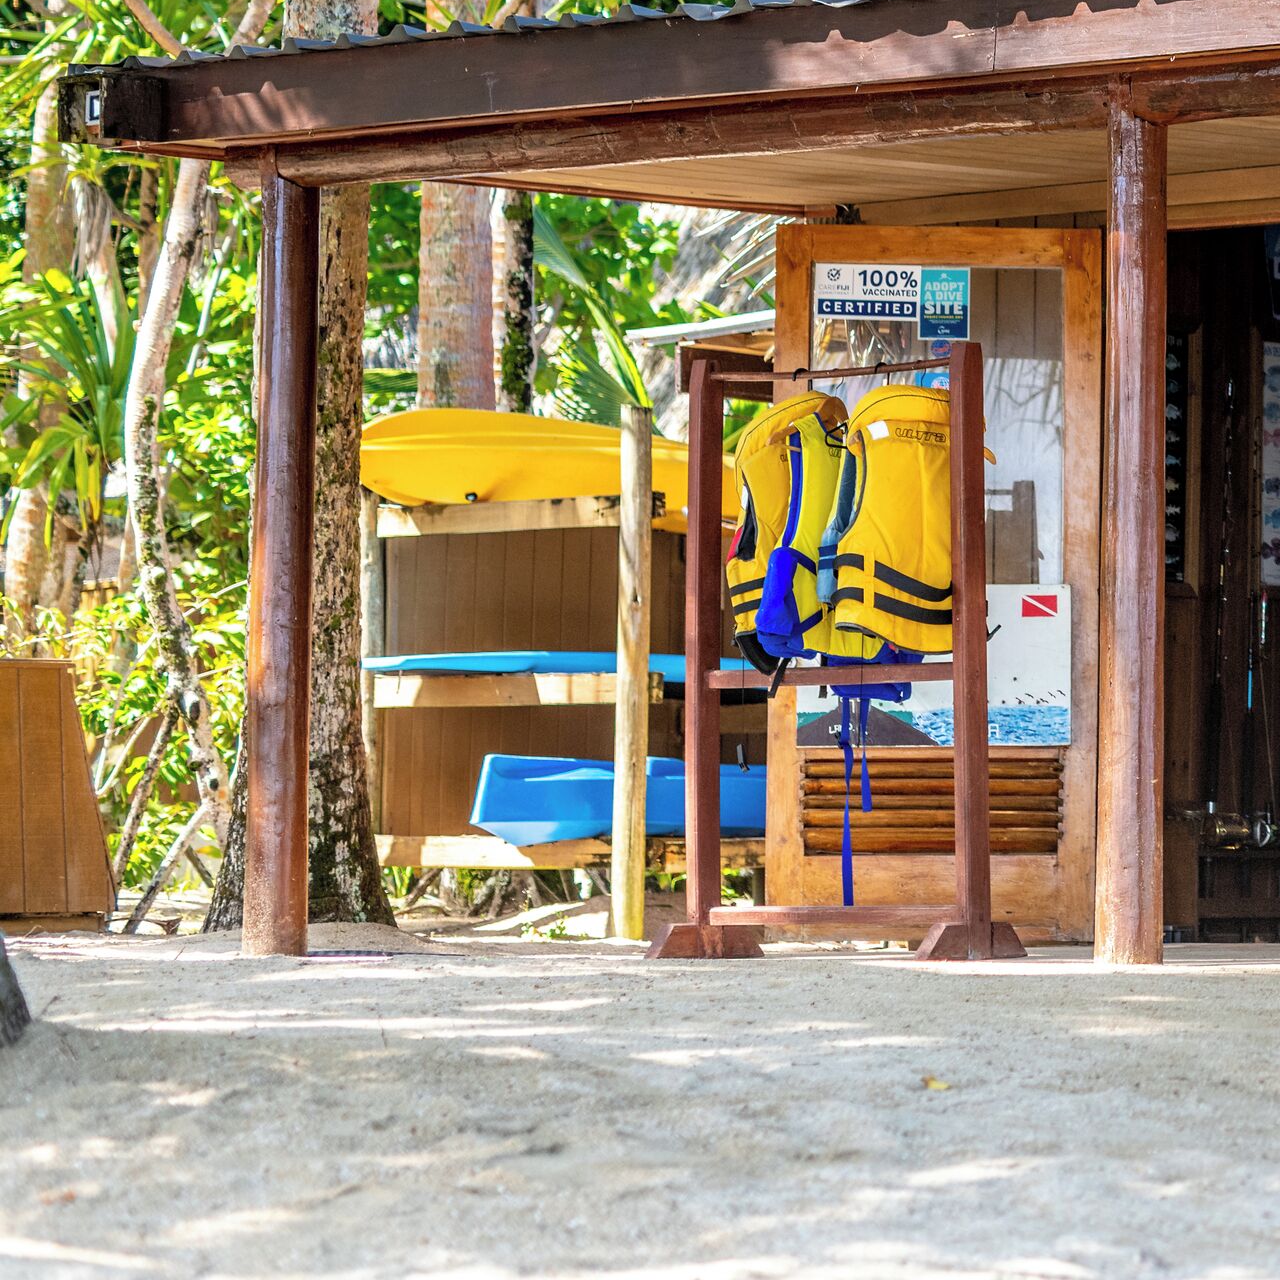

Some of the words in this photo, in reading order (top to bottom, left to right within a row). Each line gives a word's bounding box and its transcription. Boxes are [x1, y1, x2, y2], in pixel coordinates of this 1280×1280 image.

[858, 269, 918, 289] 100%
[924, 281, 965, 291] ADOPT
[862, 288, 918, 298] VACCINATED
[924, 291, 934, 300] A
[936, 291, 963, 301] DIVE
[822, 301, 913, 315] CERTIFIED
[924, 301, 964, 315] SITE
